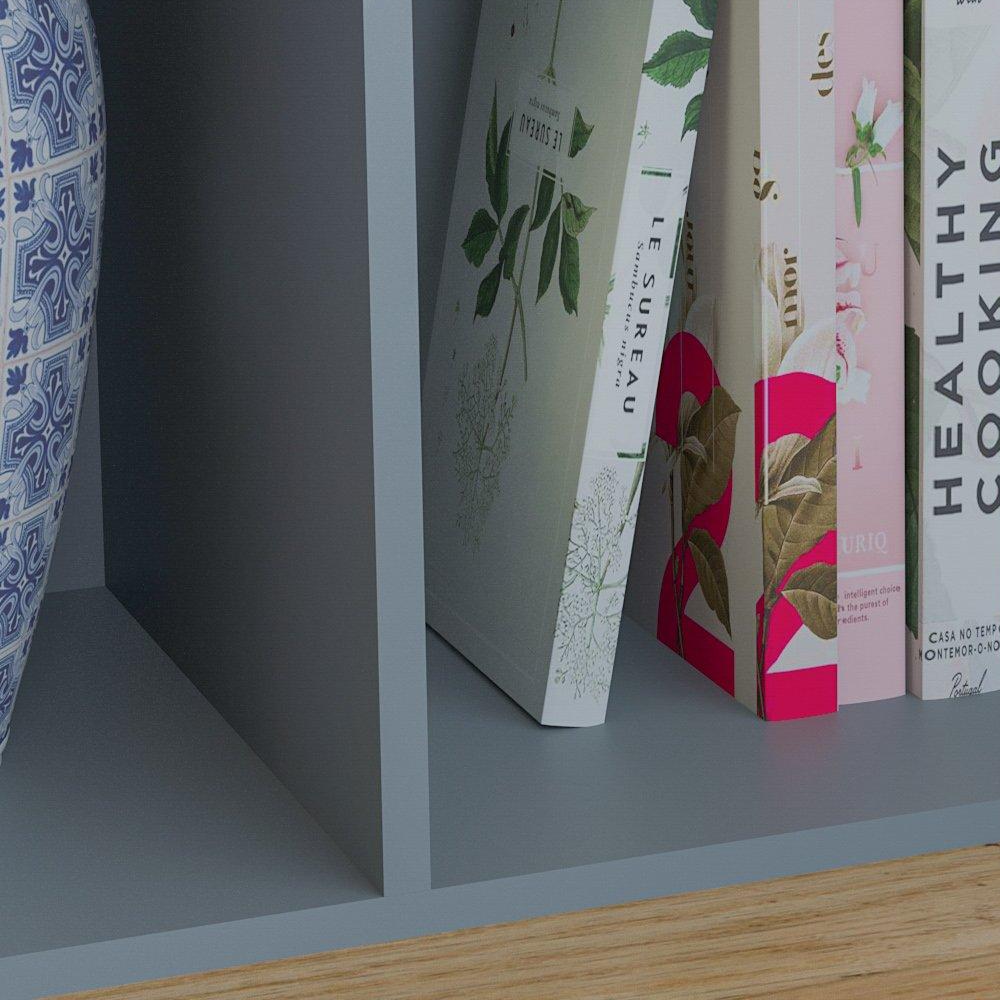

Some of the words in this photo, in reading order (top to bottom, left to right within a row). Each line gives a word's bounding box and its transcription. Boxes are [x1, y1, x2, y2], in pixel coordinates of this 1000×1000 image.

[519, 112, 551, 146] SUREAU
[553, 130, 563, 152] LE
[648, 216, 665, 252] LE
[623, 239, 645, 332] Sambucus
[622, 272, 656, 414] SUREAU
[933, 146, 965, 517] HEALTHY
[614, 339, 628, 390] nigra
[844, 586, 879, 600] intelligent
[847, 602, 857, 612] the
[859, 600, 881, 613] purest
[882, 598, 889, 607] of
[928, 631, 956, 644] CASA
[960, 628, 972, 641] NO
